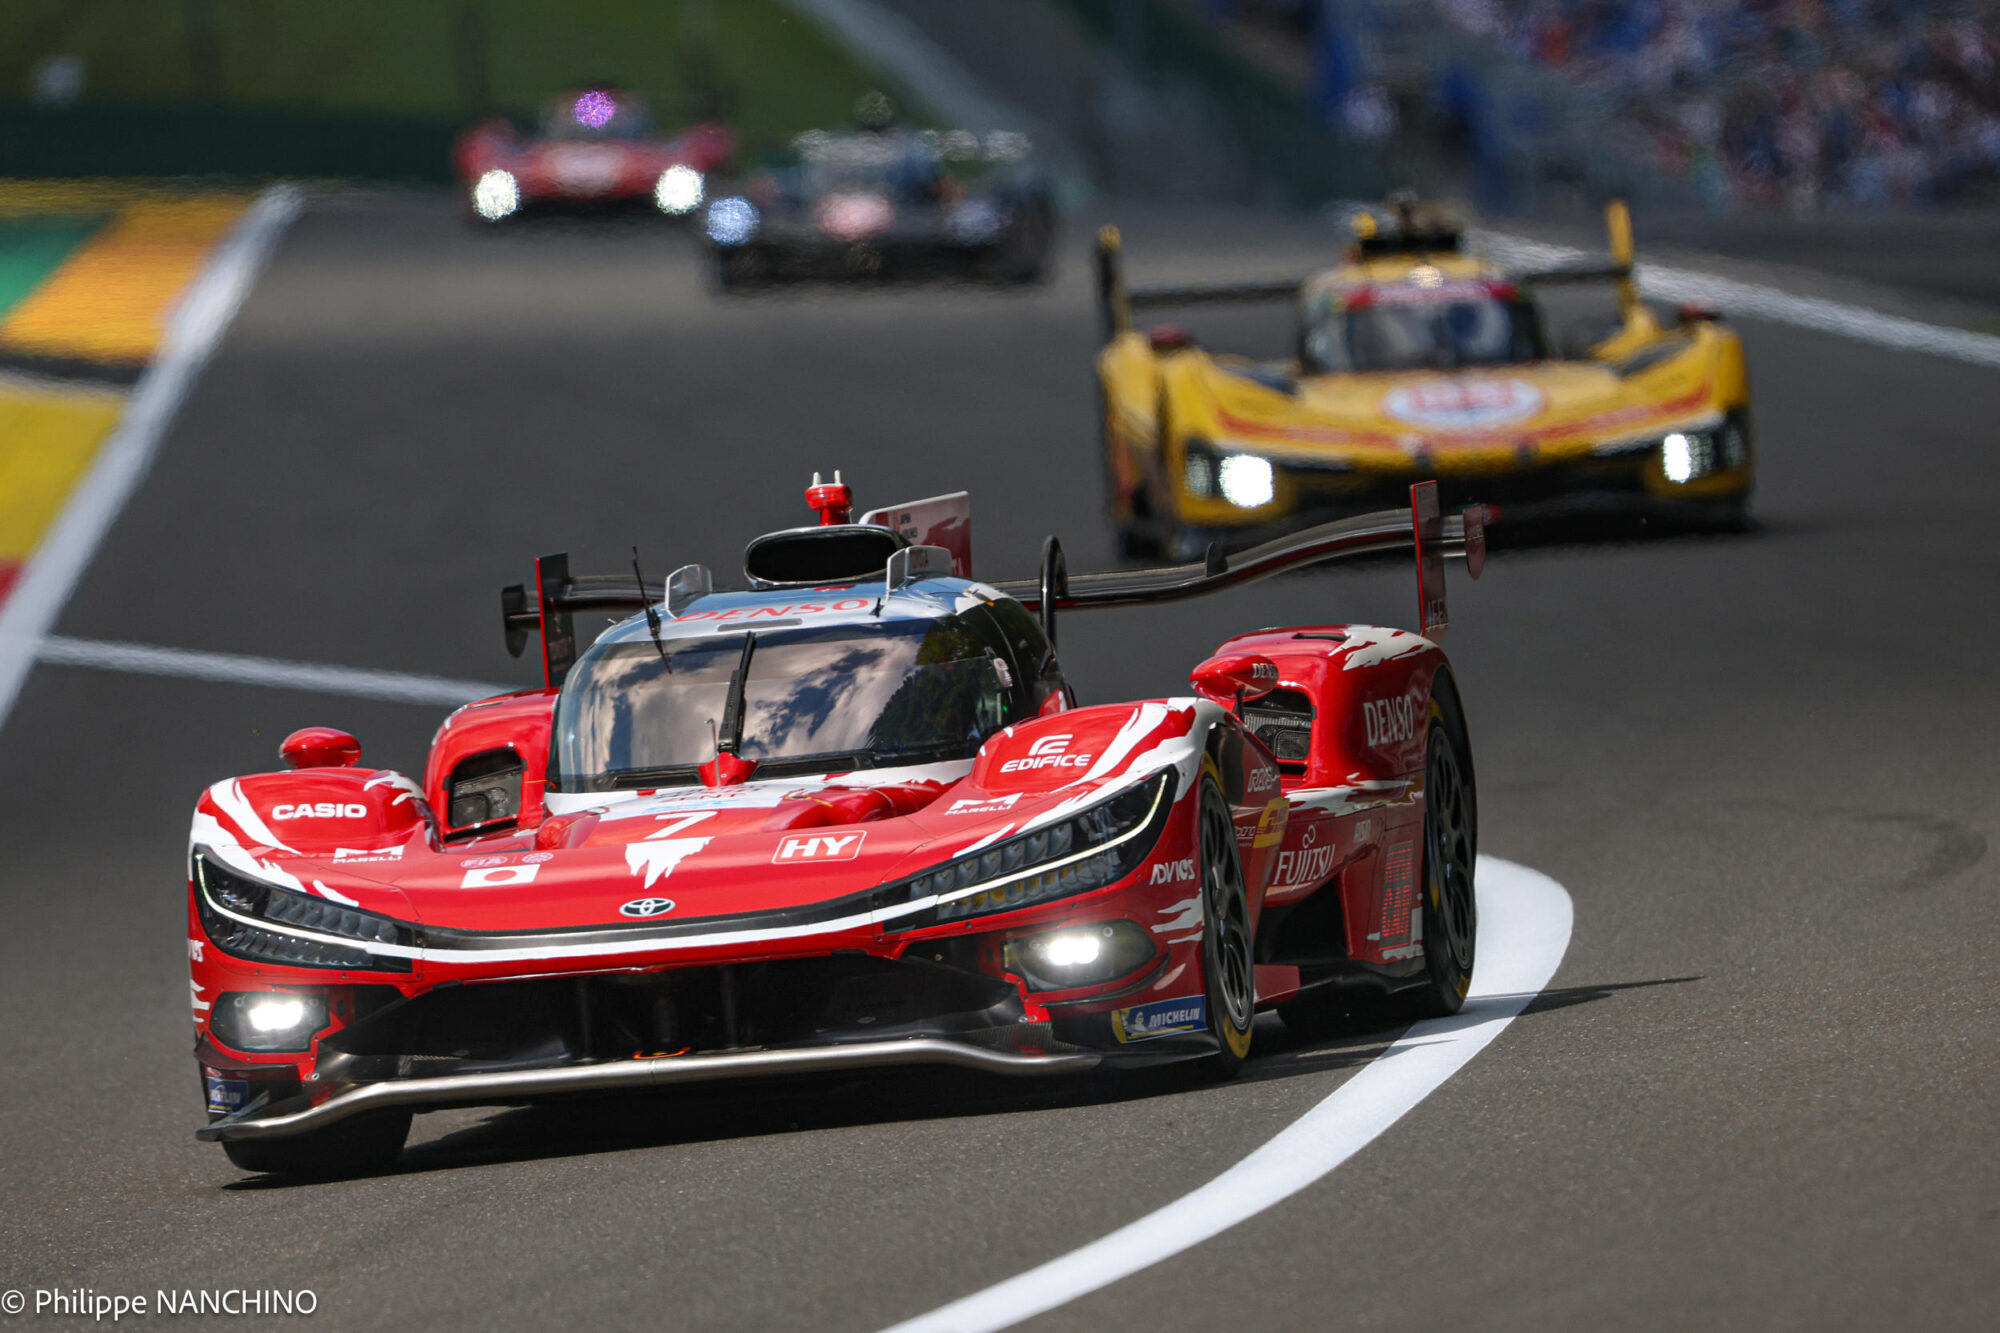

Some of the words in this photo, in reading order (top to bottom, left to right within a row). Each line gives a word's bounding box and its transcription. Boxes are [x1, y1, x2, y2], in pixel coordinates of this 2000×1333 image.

[671, 599, 869, 622] DENSO
[1363, 694, 1414, 746] DENSO
[1000, 754, 1092, 773] EDIFICE
[272, 803, 367, 820] CASIO
[643, 811, 718, 840] 7
[780, 835, 858, 858] HY
[1149, 859, 1196, 885] ADVICS
[1272, 844, 1336, 892] FUJITSU
[1148, 1007, 1201, 1028] MICHELIN
